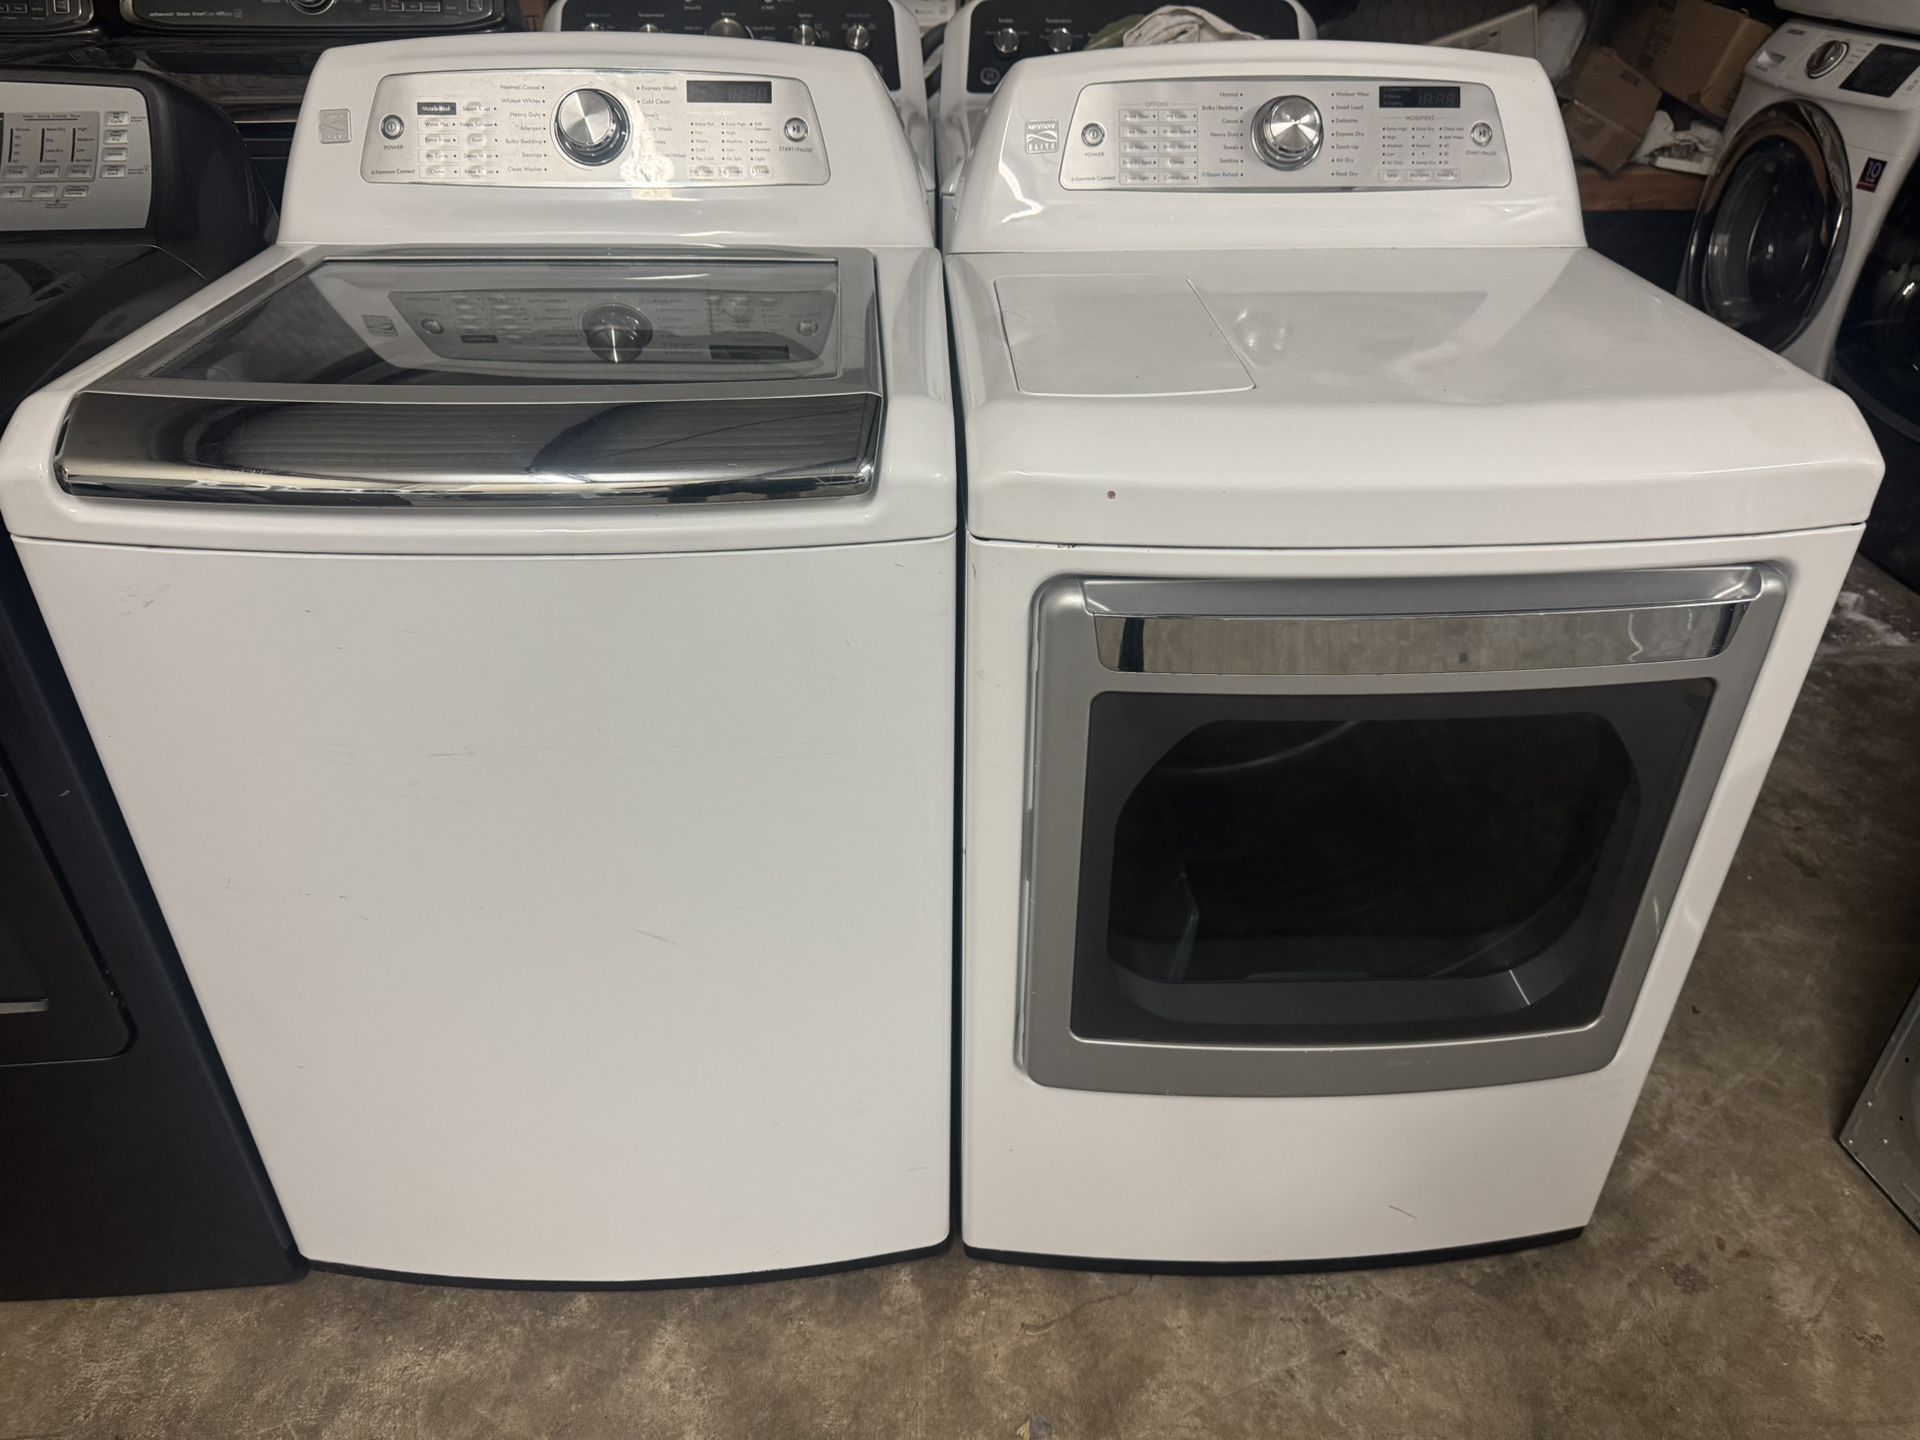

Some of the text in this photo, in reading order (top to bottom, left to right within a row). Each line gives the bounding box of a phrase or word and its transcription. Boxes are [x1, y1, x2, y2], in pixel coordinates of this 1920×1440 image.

[1028, 143, 1056, 152] ELITE
[72, 168, 87, 176] Temp
[1867, 161, 1882, 177] 10
